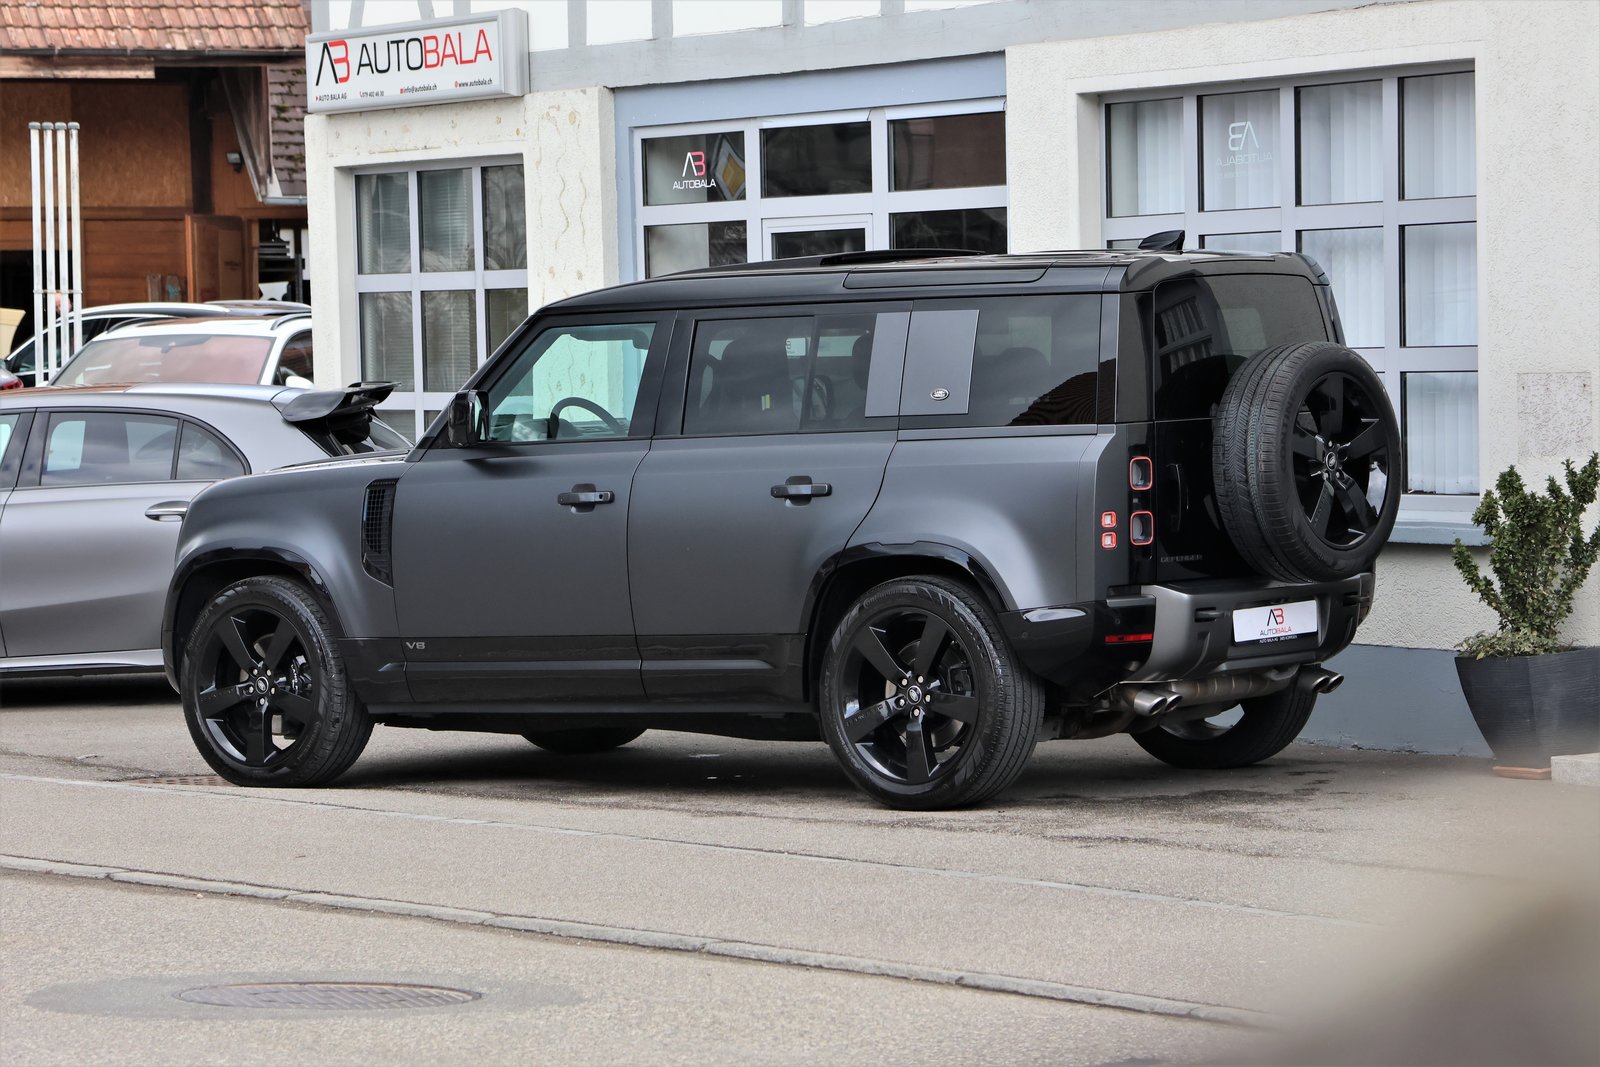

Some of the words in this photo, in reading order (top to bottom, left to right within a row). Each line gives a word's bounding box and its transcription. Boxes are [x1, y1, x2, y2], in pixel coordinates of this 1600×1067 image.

[357, 29, 492, 75] AUTOBALA
[459, 77, 493, 88] www.autobala.ch
[318, 94, 329, 102] AUTO
[673, 178, 716, 190] AUTOBALA
[1260, 626, 1293, 636] AUTOBALA
[405, 641, 426, 650] V8
